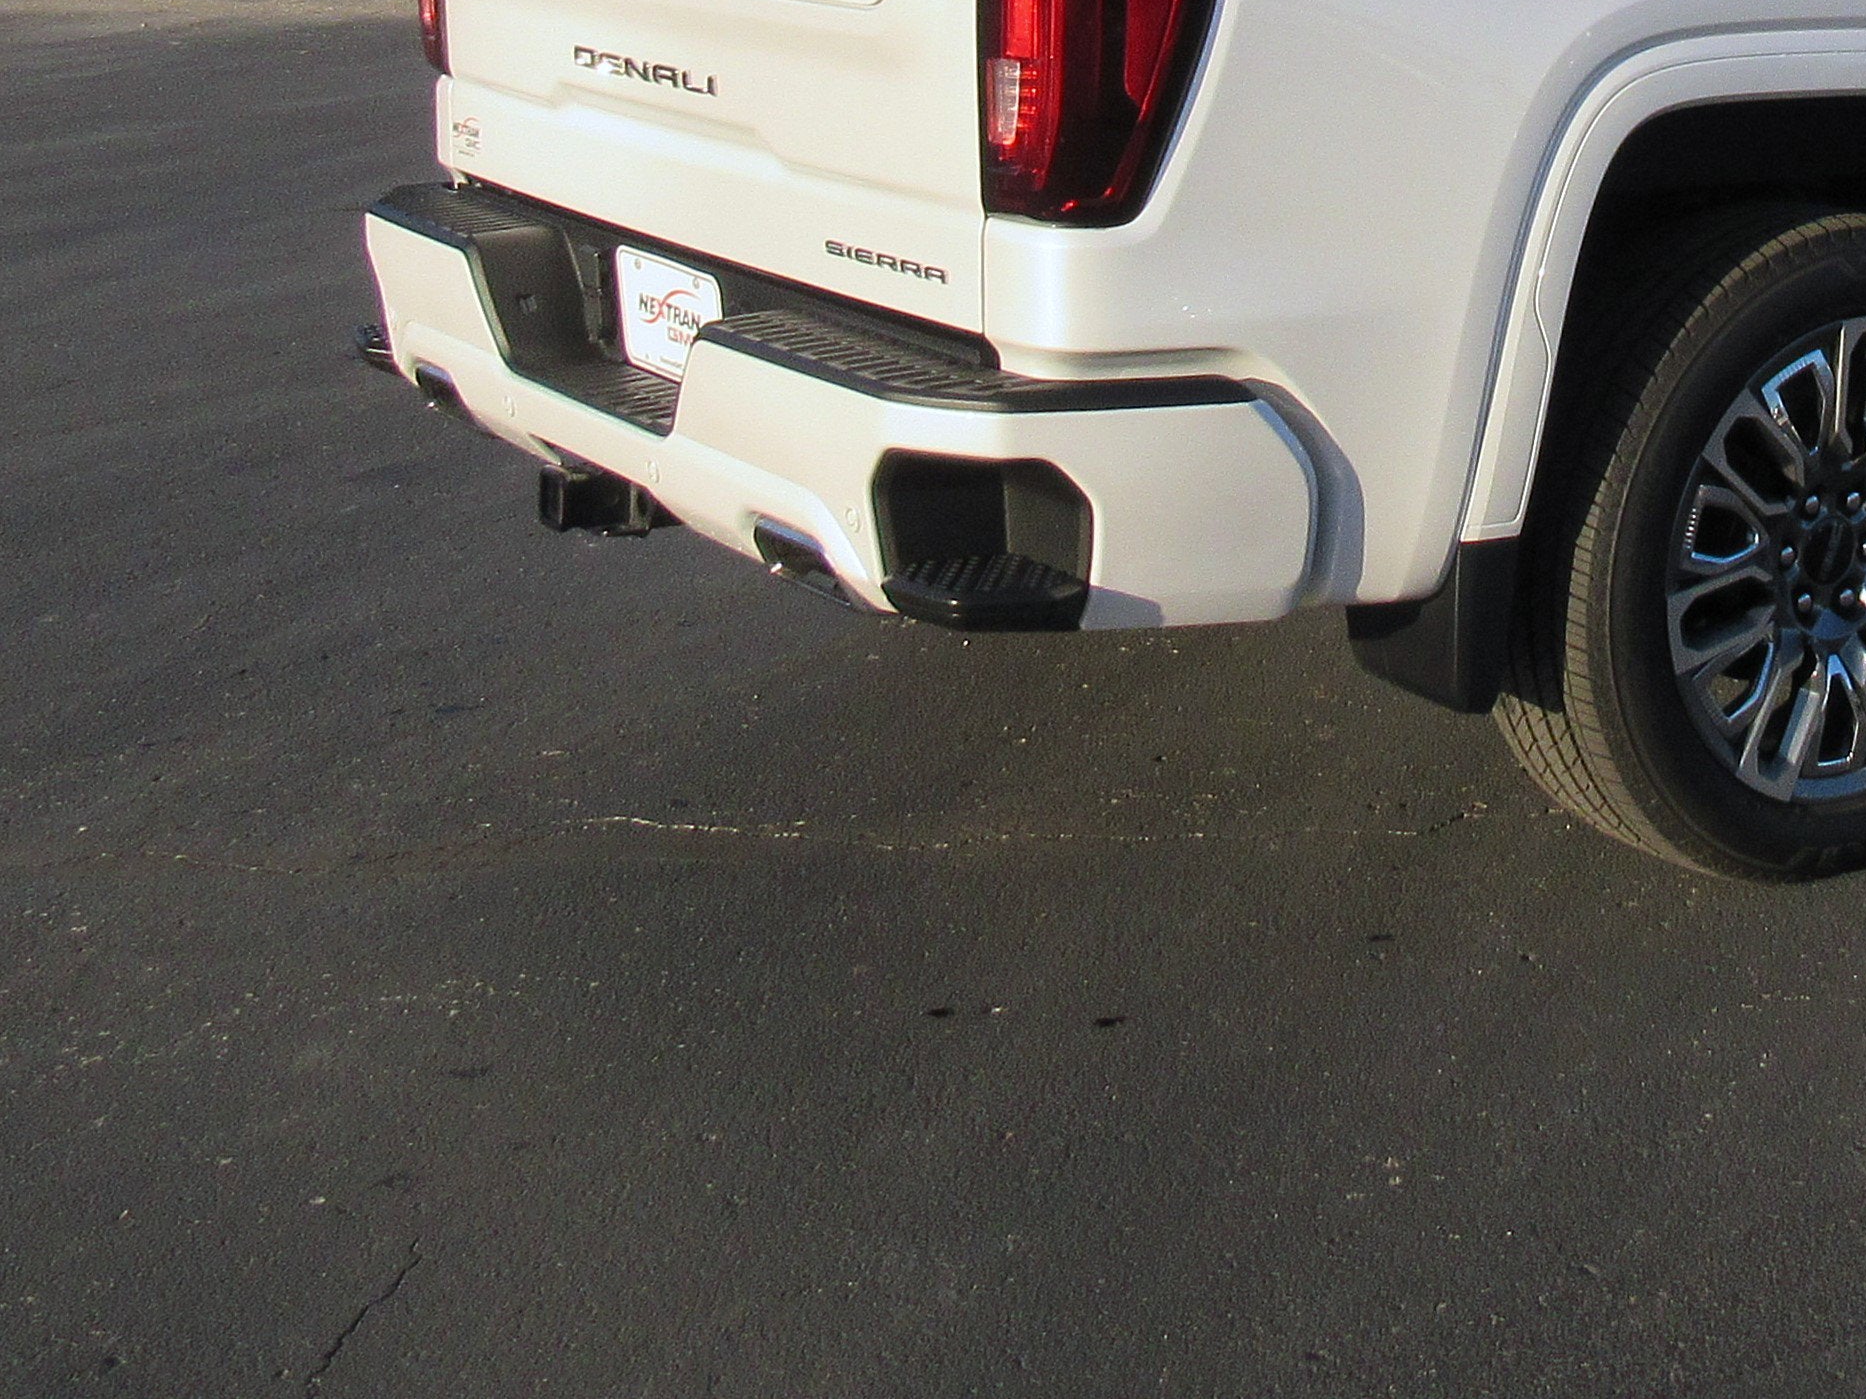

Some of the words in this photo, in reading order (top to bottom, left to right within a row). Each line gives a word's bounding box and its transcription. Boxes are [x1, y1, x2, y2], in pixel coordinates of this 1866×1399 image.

[573, 45, 718, 97] DENALI
[824, 239, 949, 285] SIERRA
[638, 292, 702, 332] NEXTRAN
[667, 326, 696, 347] GM
